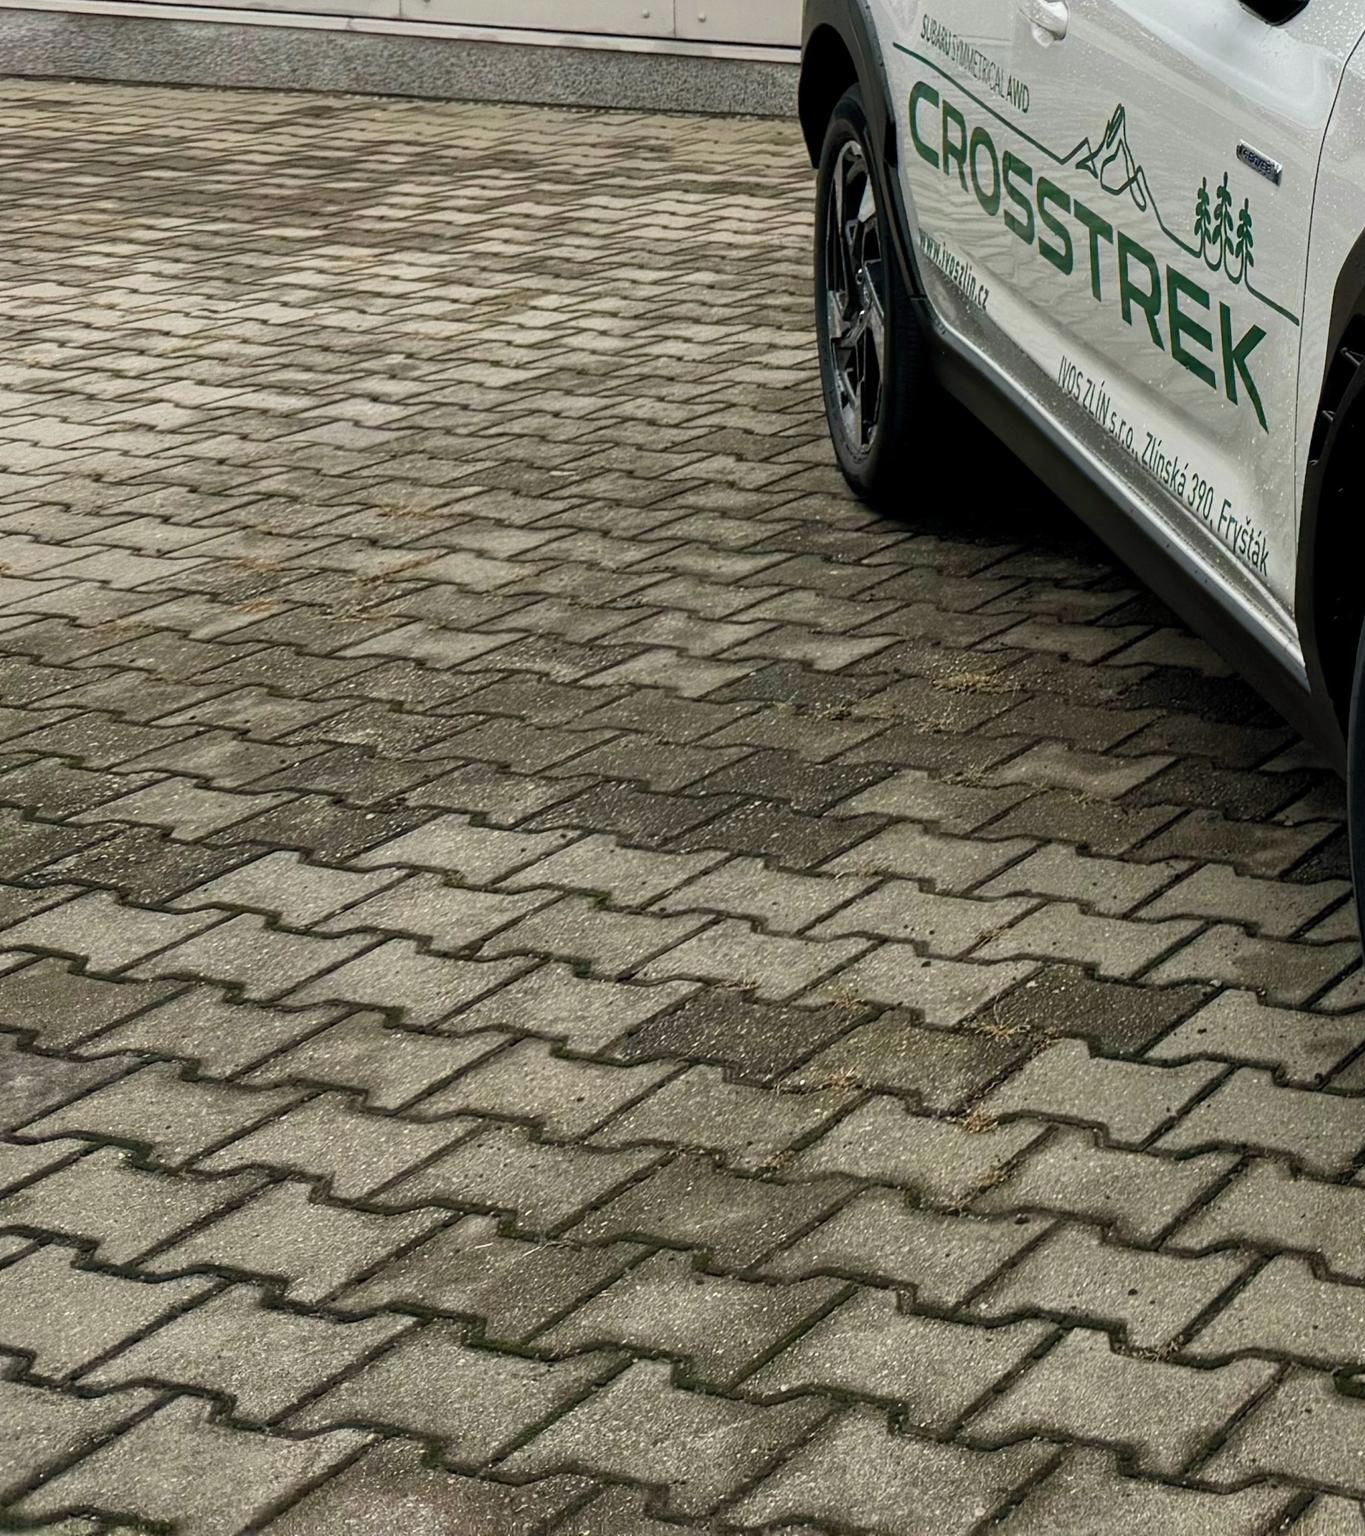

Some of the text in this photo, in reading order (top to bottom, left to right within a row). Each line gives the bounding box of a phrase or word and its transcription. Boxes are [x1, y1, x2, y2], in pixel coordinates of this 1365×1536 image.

[921, 14, 951, 56] SUBARU
[1006, 75, 1030, 113] AWD
[909, 81, 1269, 434] CROSSTREK
[1058, 355, 1083, 401] IVOS
[1082, 379, 1111, 425] ZLÍN
[1141, 432, 1190, 498] Zlínská
[1188, 473, 1214, 527] 390,
[1217, 499, 1270, 576] Fryšták
